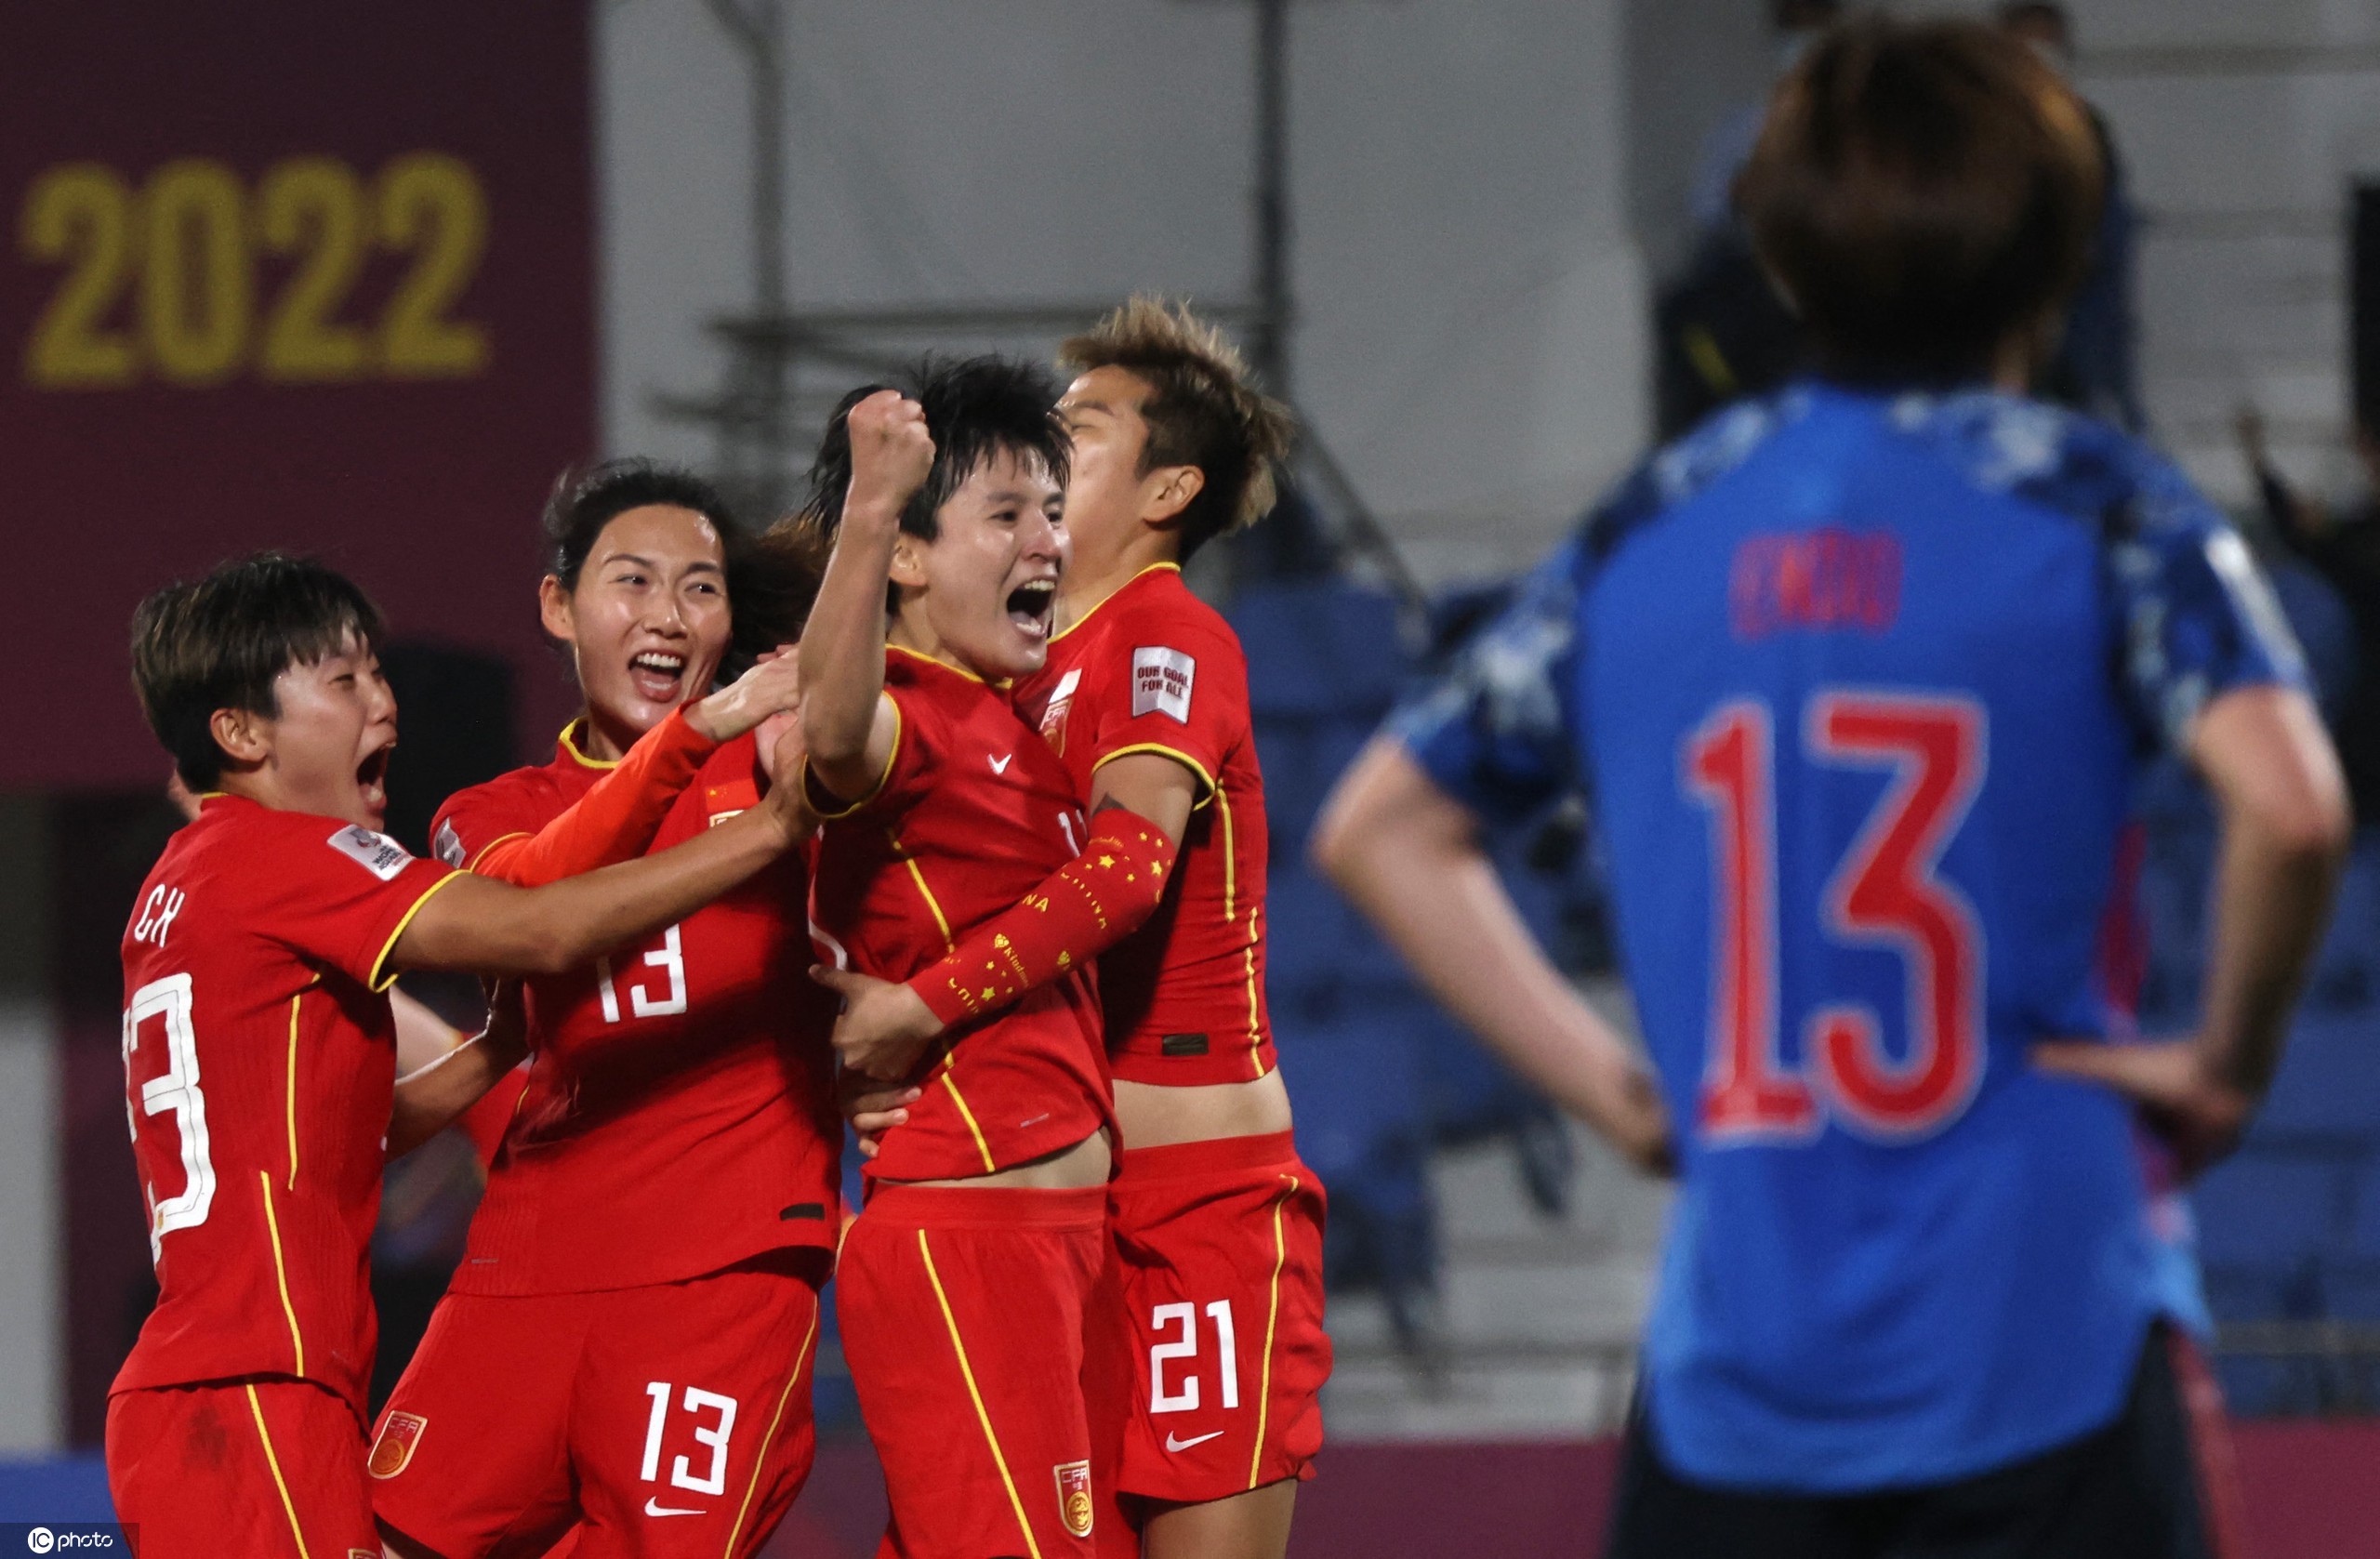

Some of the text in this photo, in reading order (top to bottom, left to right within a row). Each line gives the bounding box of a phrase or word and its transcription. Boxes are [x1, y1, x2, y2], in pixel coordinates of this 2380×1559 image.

[21, 153, 488, 386] 2022
[1138, 666, 1189, 689] OUR GOAL
[1142, 680, 1182, 699] FOR ALL
[1680, 685, 1989, 1145] 13
[1150, 1299, 1239, 1414] 21
[641, 1381, 738, 1496] 13
